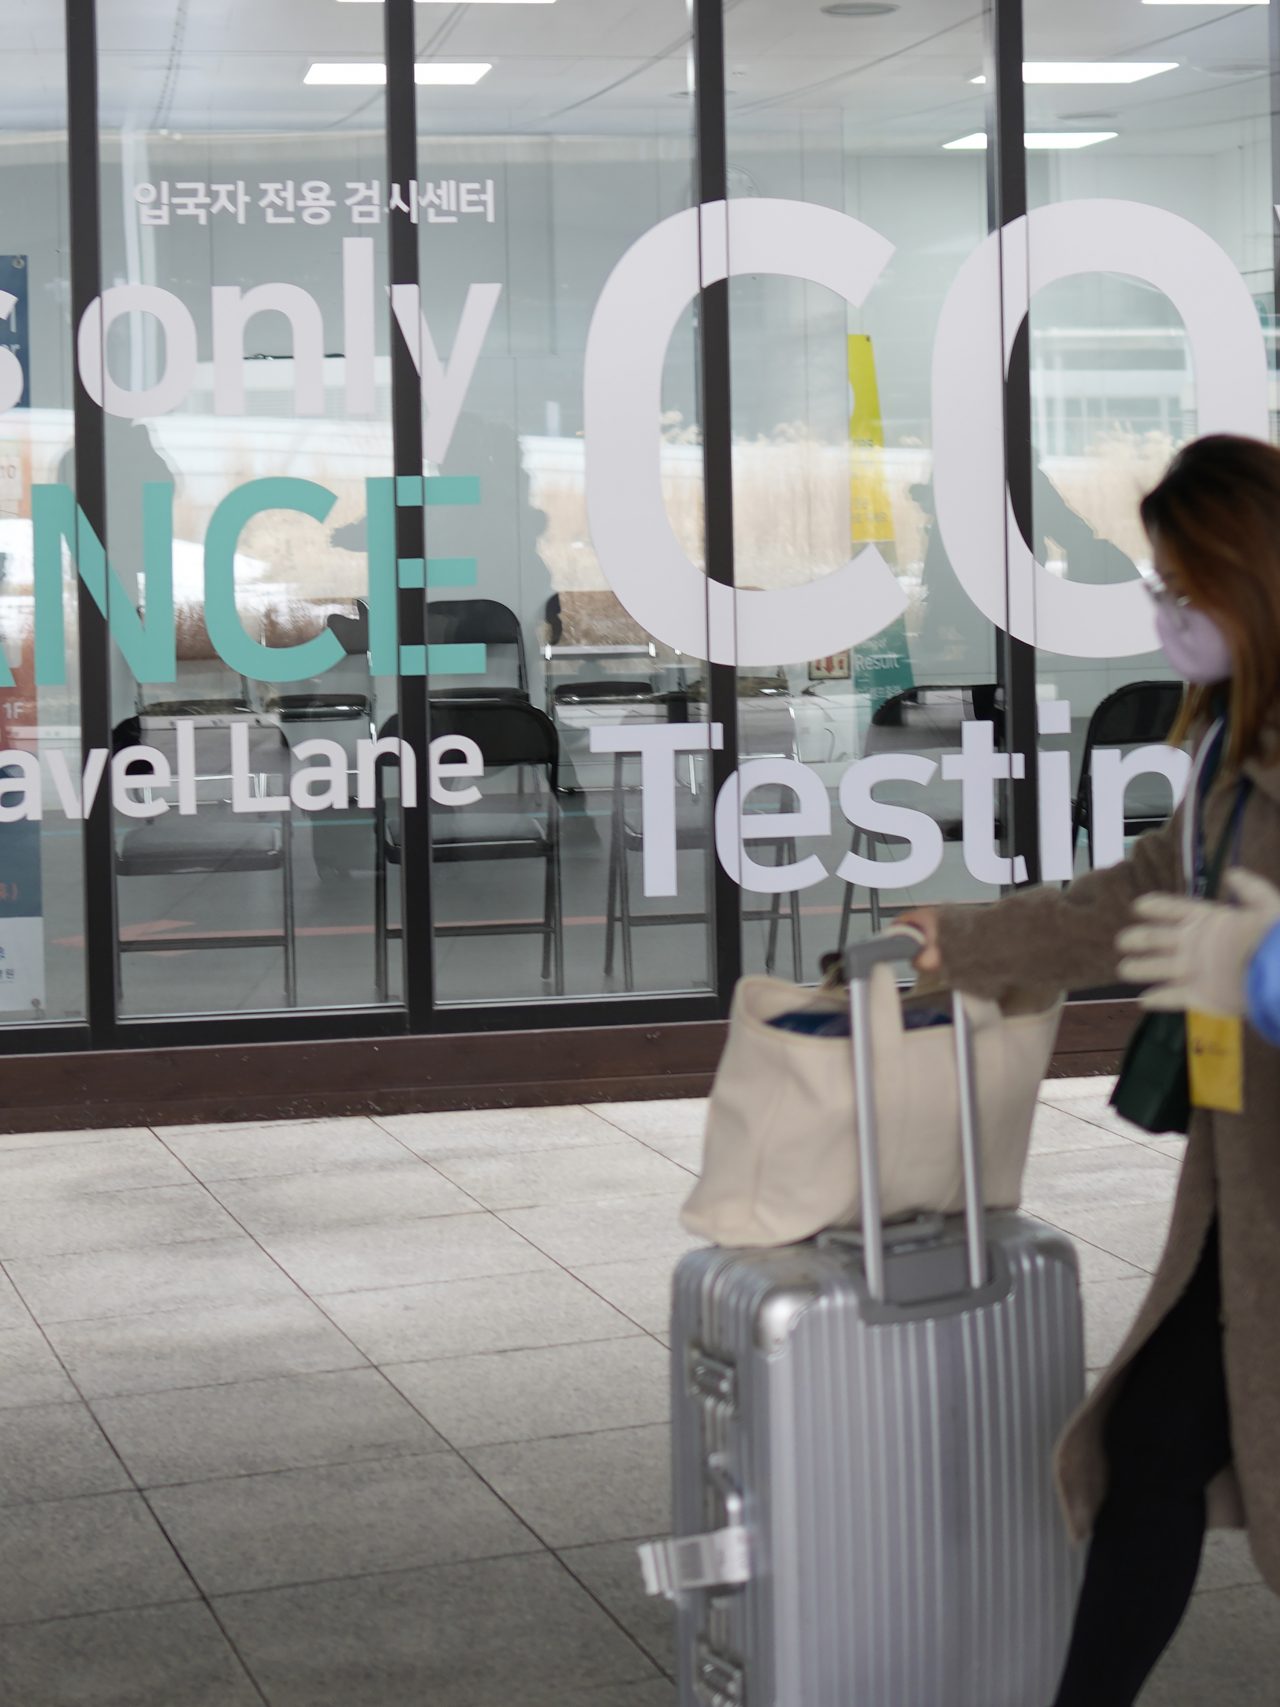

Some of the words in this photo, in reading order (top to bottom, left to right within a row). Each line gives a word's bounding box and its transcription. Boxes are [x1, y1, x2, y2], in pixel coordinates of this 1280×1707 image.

[133, 180, 250, 226] 입국자
[258, 180, 336, 226] 전용
[77, 236, 502, 465] only
[0, 475, 487, 688] NCE
[230, 720, 485, 814] Lane
[589, 699, 1193, 897] Testin
